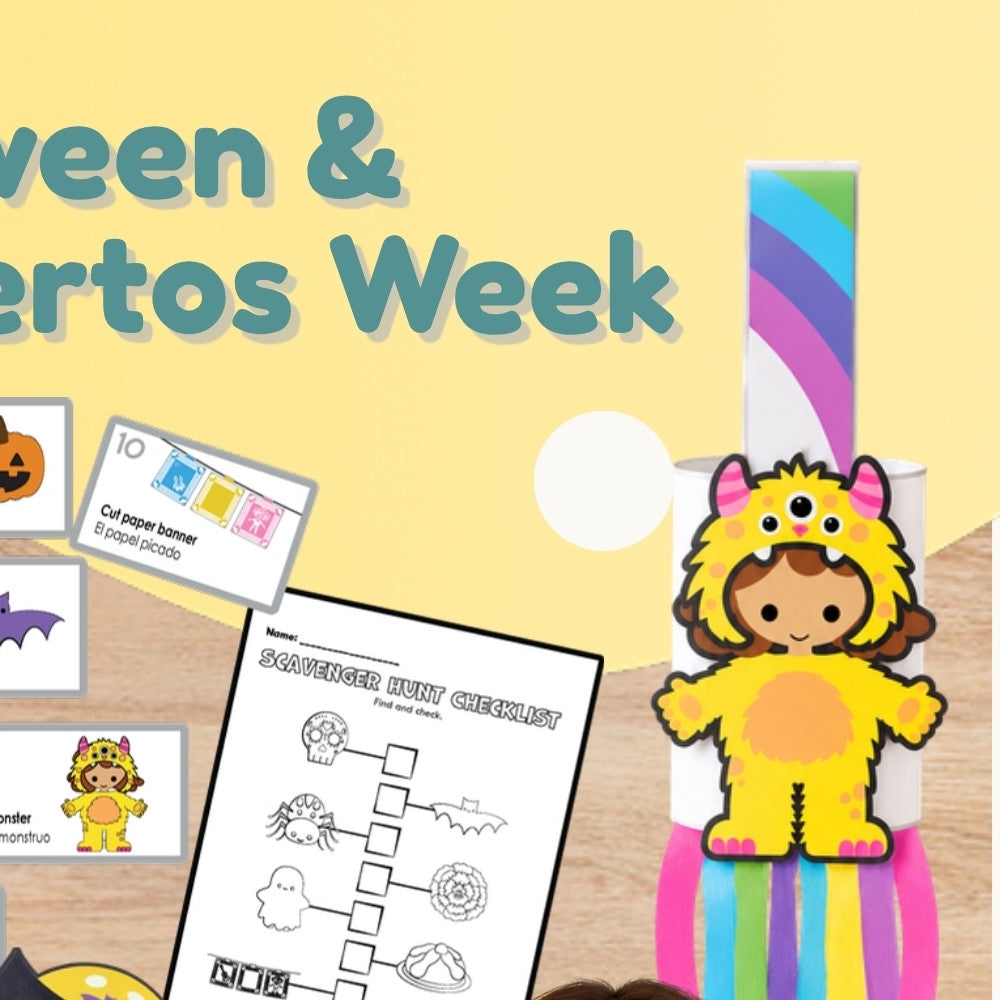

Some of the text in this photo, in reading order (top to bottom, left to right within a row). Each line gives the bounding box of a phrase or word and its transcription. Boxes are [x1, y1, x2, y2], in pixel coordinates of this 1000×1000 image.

[116, 432, 146, 460] 10
[94, 521, 181, 560] El papel picado
[100, 503, 198, 547] Cut paper banner
[266, 627, 298, 642] Name:
[258, 648, 562, 730] SCAVENGER HUNT CHECKLIST
[373, 697, 443, 720] Find and check.
